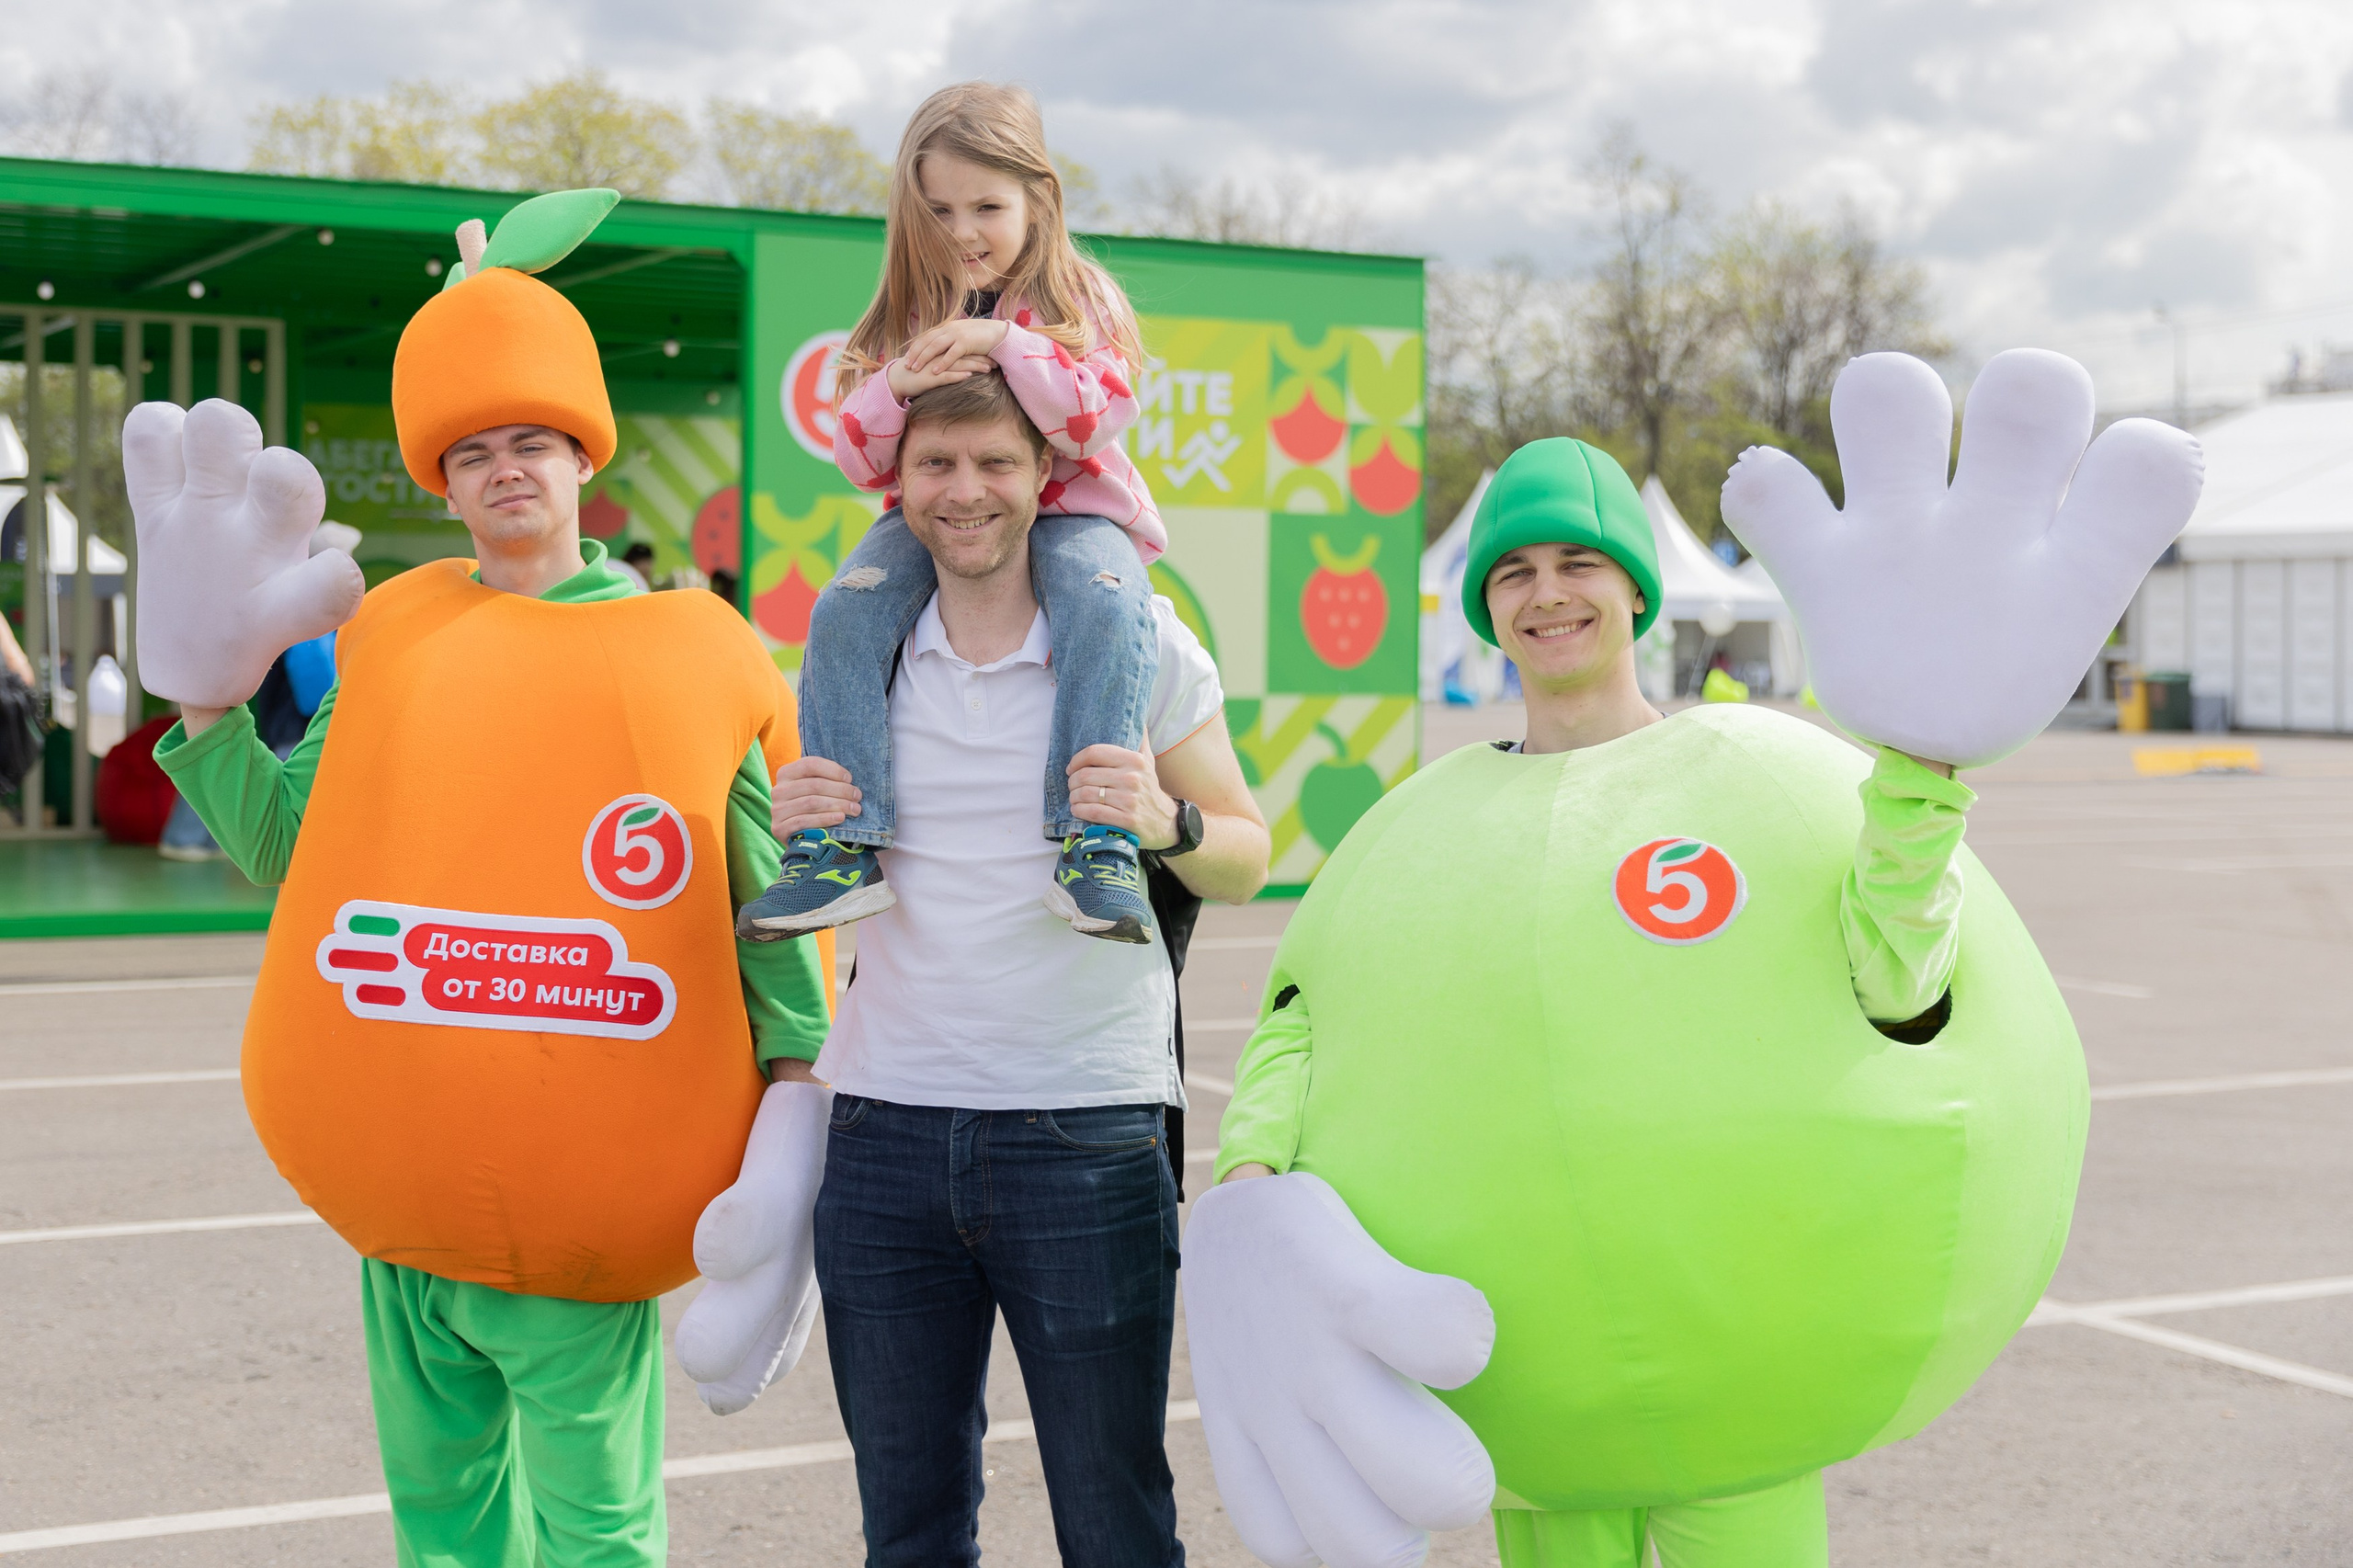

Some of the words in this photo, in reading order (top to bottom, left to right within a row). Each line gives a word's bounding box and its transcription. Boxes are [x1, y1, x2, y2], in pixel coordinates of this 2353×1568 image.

[1135, 358, 1233, 415] ЙТЕ
[613, 801, 665, 886] 5
[1645, 840, 1709, 925] 5
[423, 932, 589, 967] Доставка
[442, 978, 482, 1000] от
[489, 977, 527, 1003] 30
[535, 983, 645, 1016] минут
